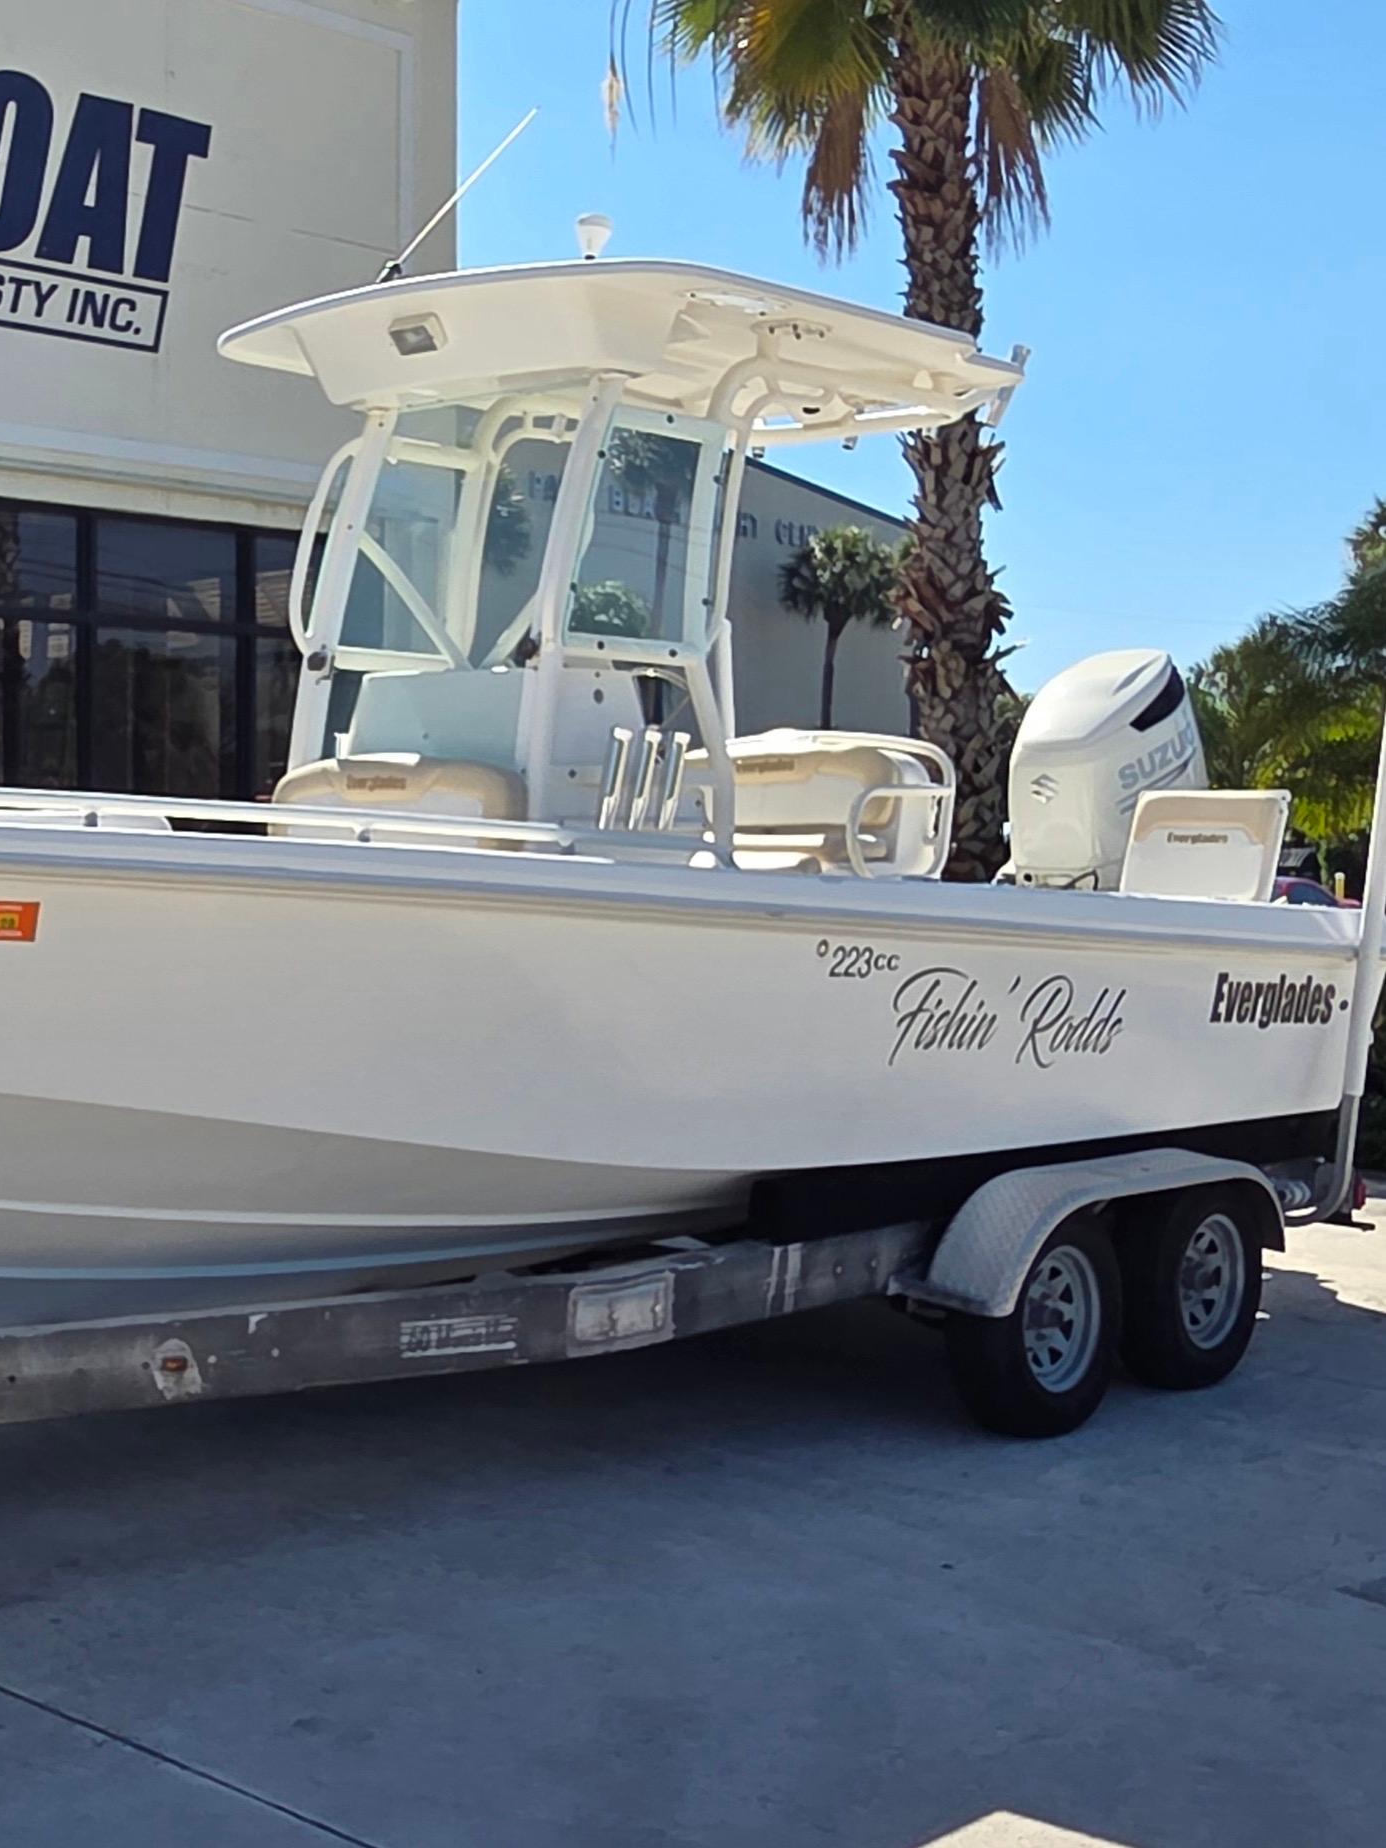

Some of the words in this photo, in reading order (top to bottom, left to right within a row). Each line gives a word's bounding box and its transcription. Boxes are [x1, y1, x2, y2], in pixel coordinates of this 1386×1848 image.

[66, 284, 142, 336] INC.
[1117, 719, 1195, 790] SUZU
[1014, 974, 1128, 1069] Rodds
[1209, 971, 1337, 1030] Everglades
